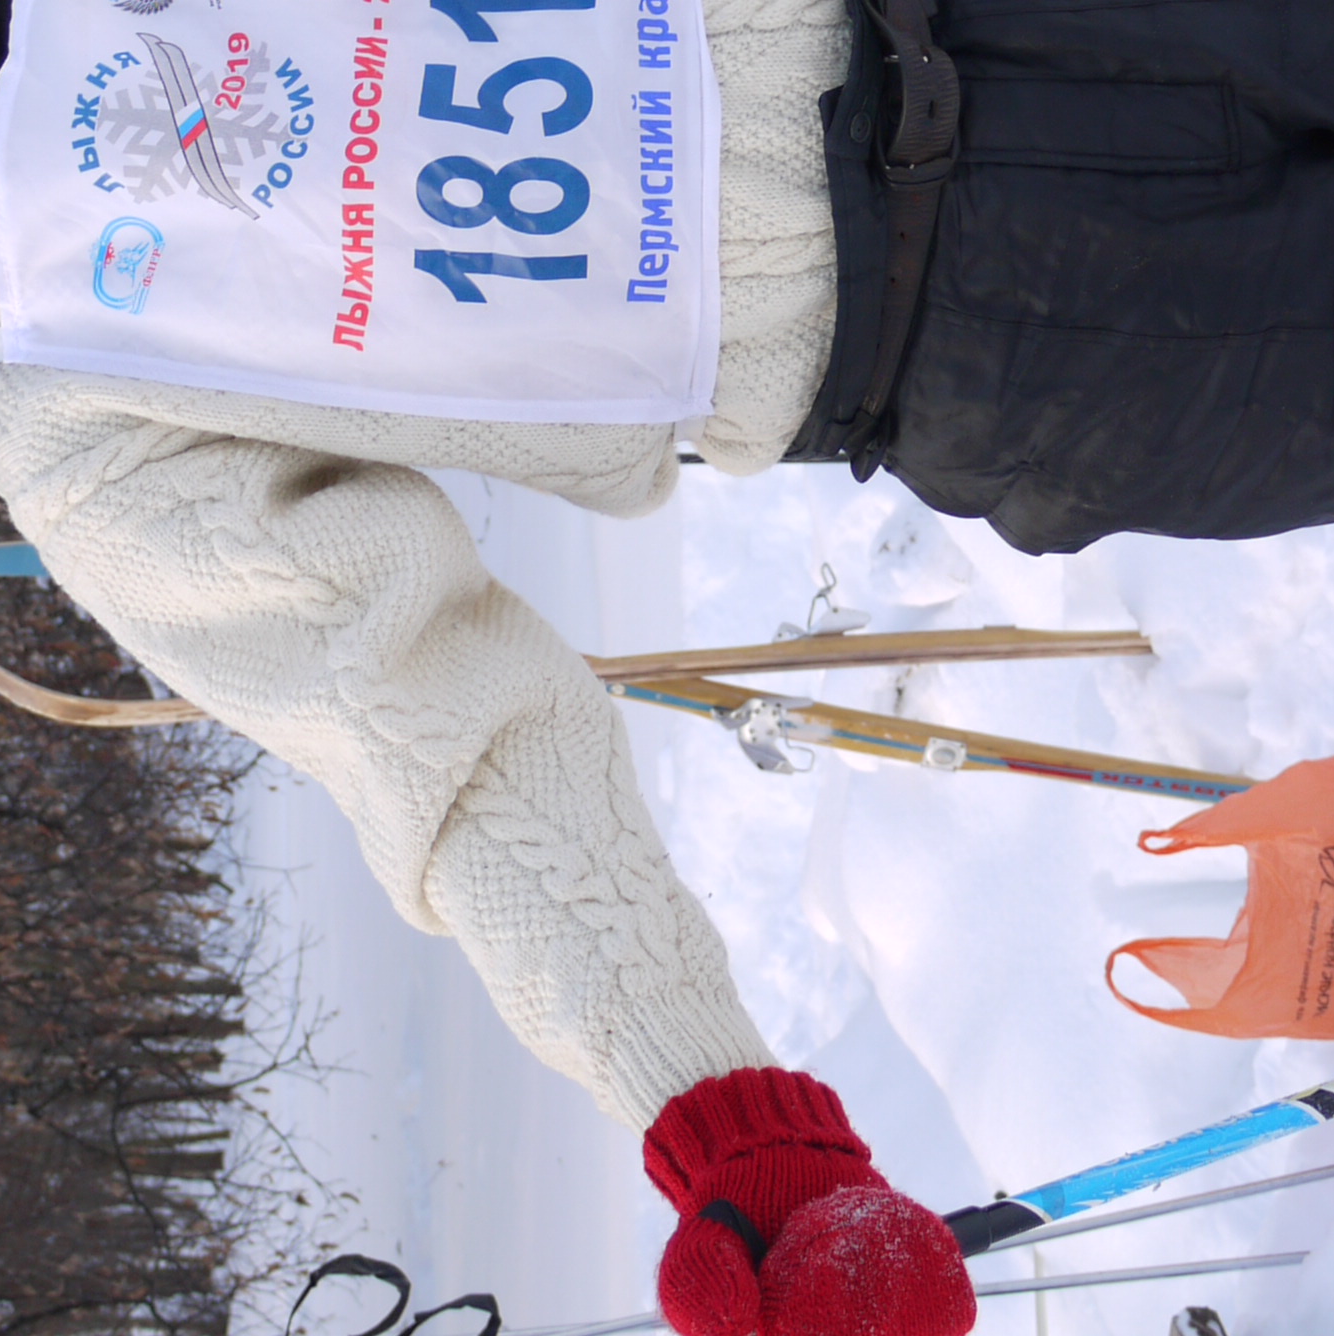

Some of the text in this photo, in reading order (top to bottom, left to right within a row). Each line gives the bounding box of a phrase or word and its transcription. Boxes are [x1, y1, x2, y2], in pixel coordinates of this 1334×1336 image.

[71, 50, 141, 193] ЛЫЖНЯ
[215, 32, 251, 110] 2019
[251, 58, 315, 209] РОССИИ
[342, 36, 388, 190] РОССИИ
[626, 90, 679, 304] Пермский
[332, 203, 374, 352] ЛЫЖНЯ
